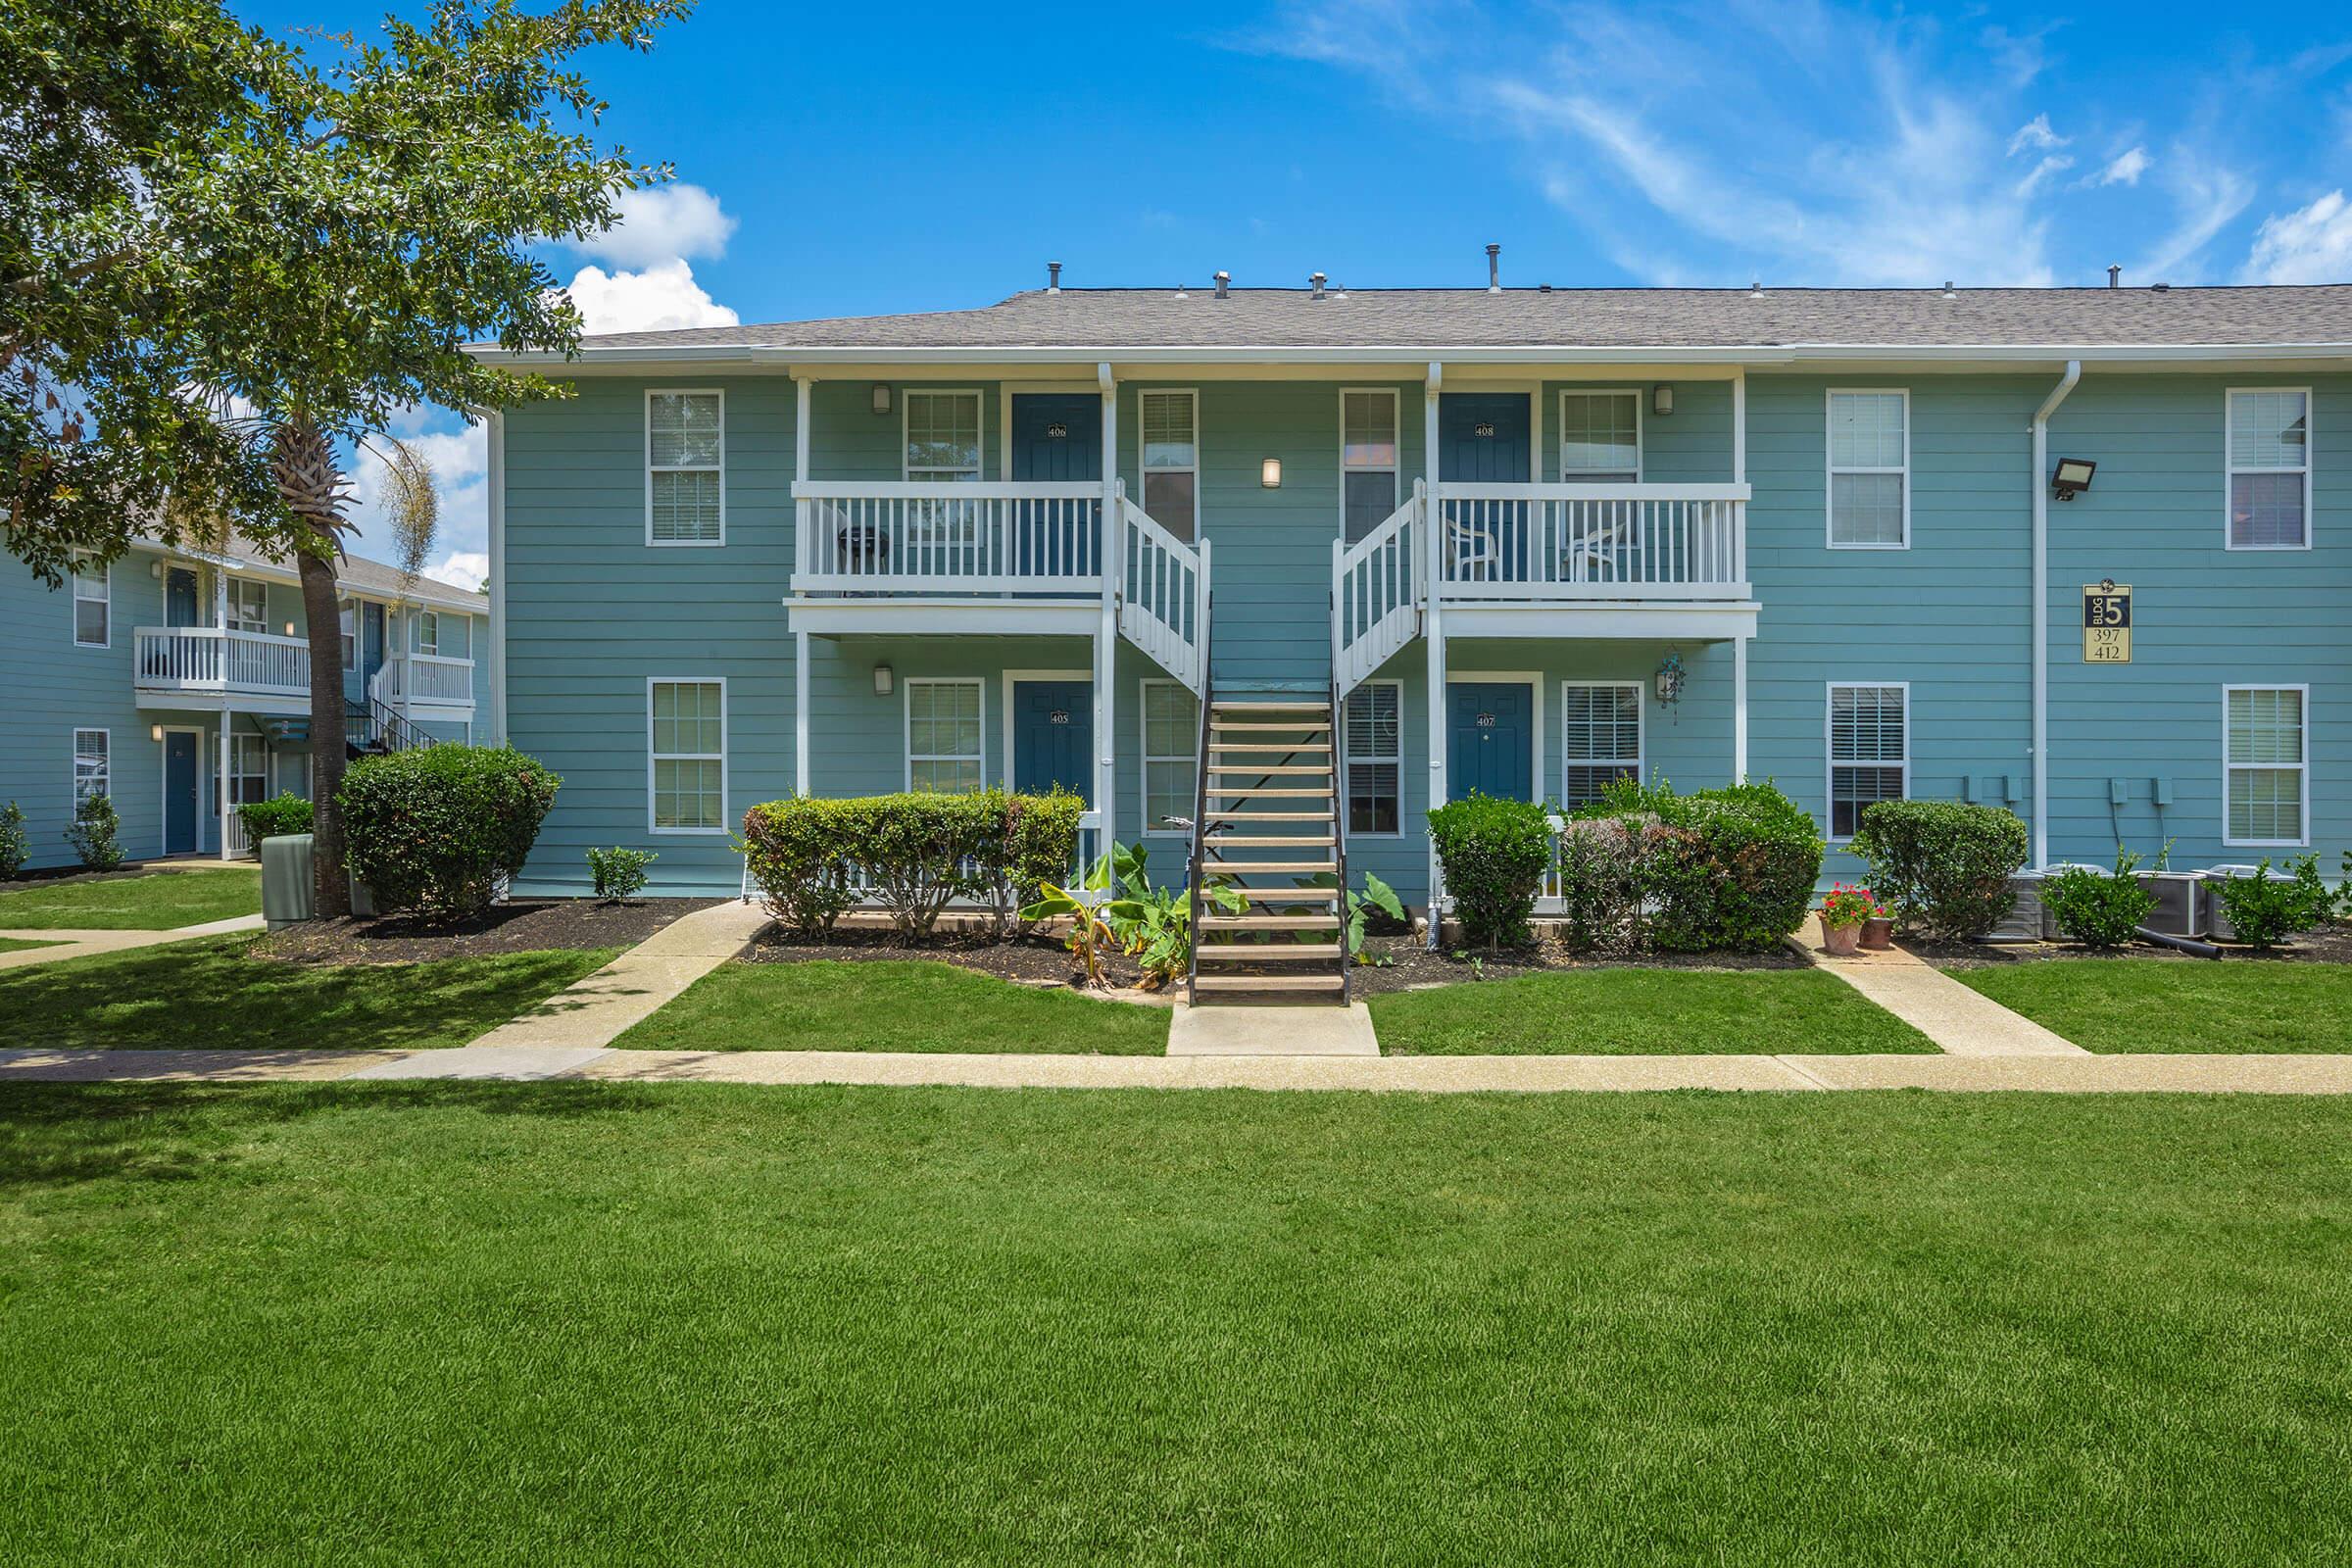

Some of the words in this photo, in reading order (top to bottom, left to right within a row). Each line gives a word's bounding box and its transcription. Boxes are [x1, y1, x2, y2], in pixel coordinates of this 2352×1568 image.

[1049, 428, 1066, 437] 406
[1475, 427, 1494, 436] 408
[2093, 597, 2103, 625] BLDG
[2104, 598, 2123, 624] 5
[2093, 629, 2120, 642] 397
[2094, 646, 2120, 659] 412
[1051, 714, 1068, 723] 405
[1477, 716, 1494, 726] 407
